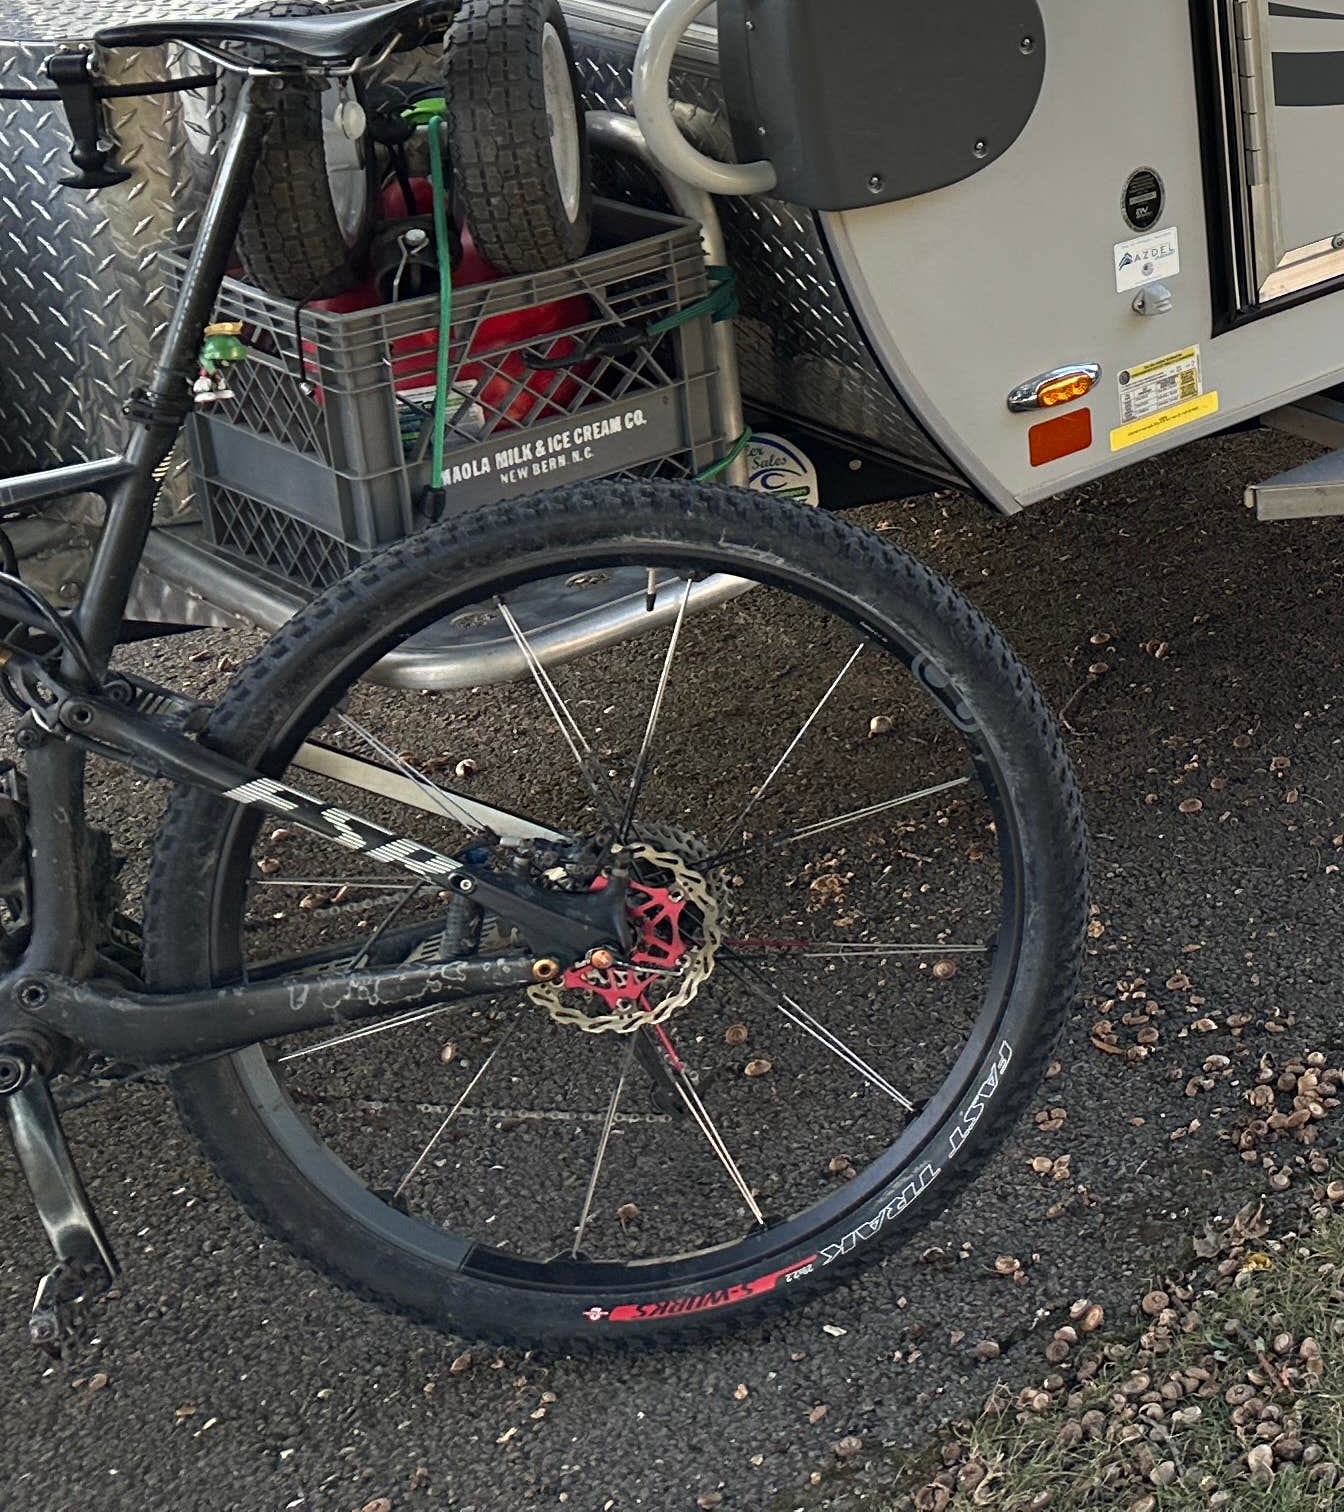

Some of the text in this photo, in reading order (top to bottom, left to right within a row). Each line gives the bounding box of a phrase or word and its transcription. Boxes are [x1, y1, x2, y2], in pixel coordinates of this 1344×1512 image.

[1134, 242, 1175, 263] AZDEL
[441, 409, 647, 486] MAOLA MILK & ICE CREAM CO.
[500, 466, 528, 485] NEW
[752, 454, 787, 470] Sales
[820, 1040, 1012, 1266] FAST TRAK
[632, 1284, 754, 1319] S-WORKS
